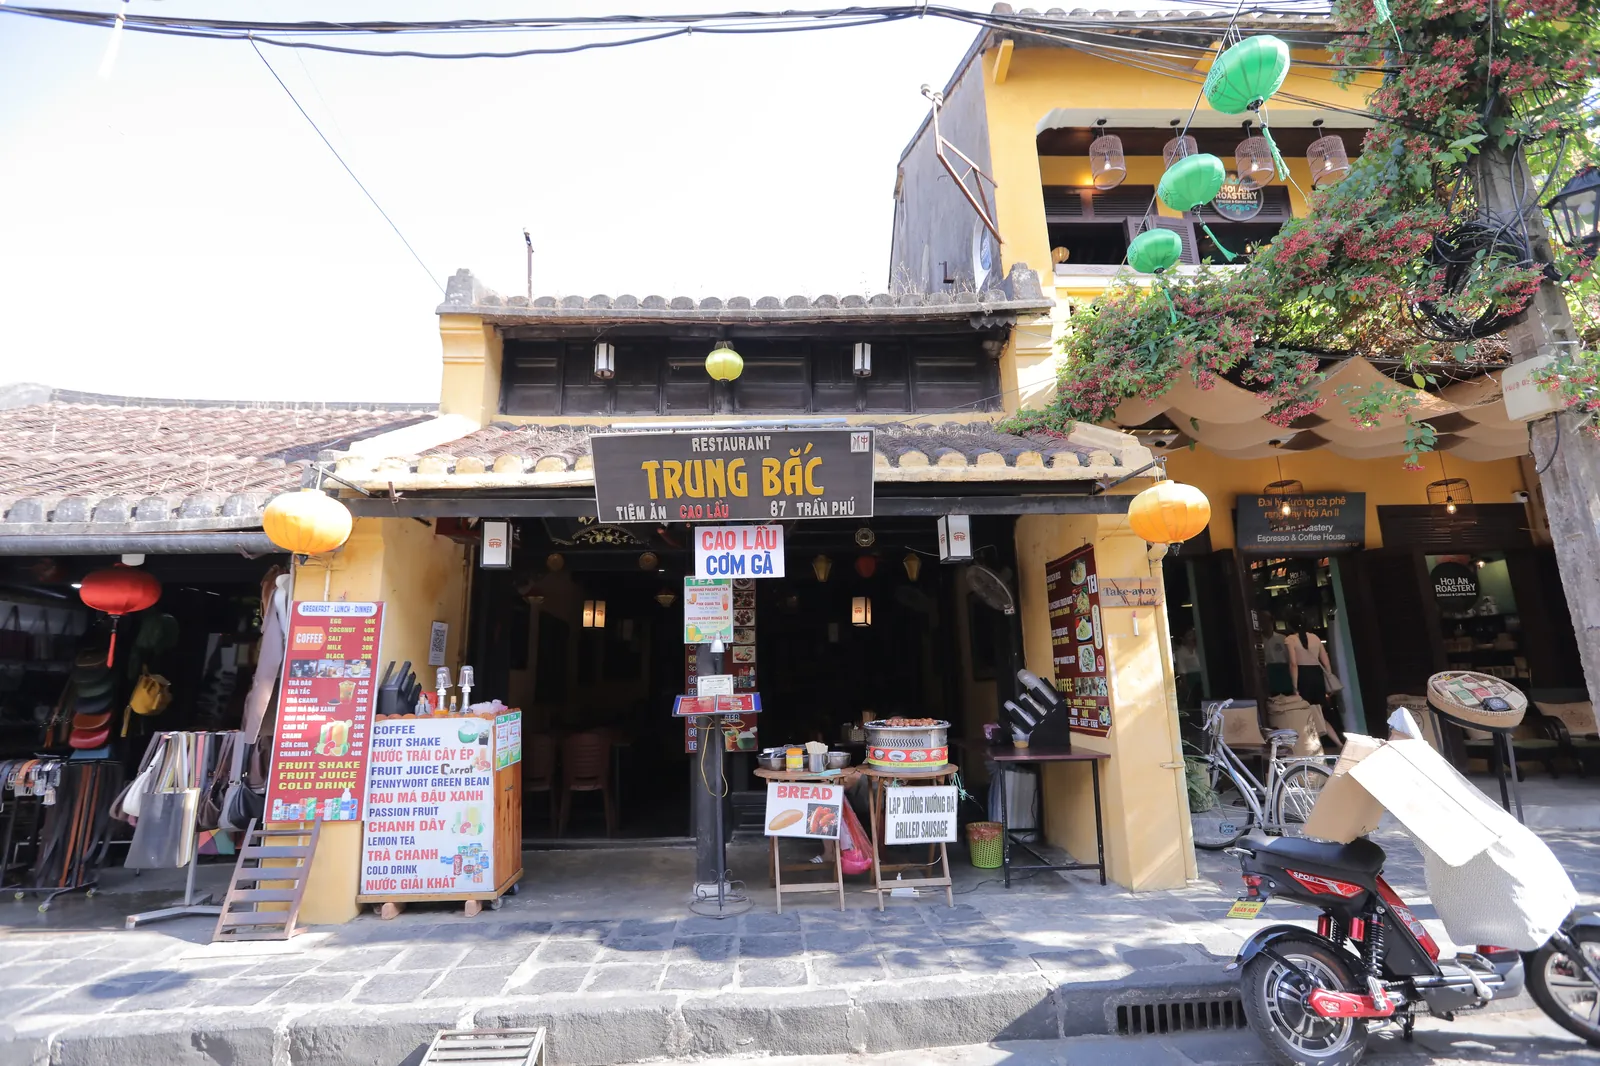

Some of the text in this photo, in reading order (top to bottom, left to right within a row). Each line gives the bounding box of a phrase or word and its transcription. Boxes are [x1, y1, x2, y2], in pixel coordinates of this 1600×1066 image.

[691, 436, 771, 452] RESTAURANT
[641, 442, 824, 500] TRUNG BẮC
[1330, 496, 1346, 508] phê
[616, 503, 645, 522] TIỆM
[650, 502, 667, 520] ĂN
[680, 504, 701, 519] CAO
[770, 501, 786, 517] 87
[796, 498, 828, 517] TRẦN
[832, 496, 855, 516] PHÚ
[1321, 508, 1333, 518] An
[702, 530, 736, 551] CAO
[1257, 534, 1290, 542] Espresso
[1298, 533, 1321, 541] Coffee
[1322, 532, 1346, 540] House
[706, 550, 774, 576] CƠM GÀ
[1458, 576, 1468, 584] AN
[1102, 588, 1157, 596] Take-away
[1435, 583, 1476, 592] ROASTERY
[296, 633, 323, 643] COFFEE
[374, 725, 415, 735] COFFEE
[372, 737, 440, 747] FRUIT SHAKE
[372, 747, 474, 763] NƯỚC TRÁI CÂY ÉP
[371, 765, 439, 776] FRUIT JUICE
[370, 777, 490, 789] PENNYWORT GREEN BEAN
[370, 790, 483, 805] RAU MÁ ĐẬU XANH
[777, 785, 832, 800] BREAD
[370, 807, 410, 817] PASSION
[413, 806, 439, 816] FRUIT
[368, 818, 446, 833] CHANH DÂY
[895, 820, 948, 839] GRILLED SAUSAGE
[368, 836, 415, 846] LEMON TEA
[368, 848, 439, 861] TRÀ CHANH
[367, 864, 417, 875] COLD DRINK
[366, 874, 456, 891] NƯỚC GIẢI KHÁT
